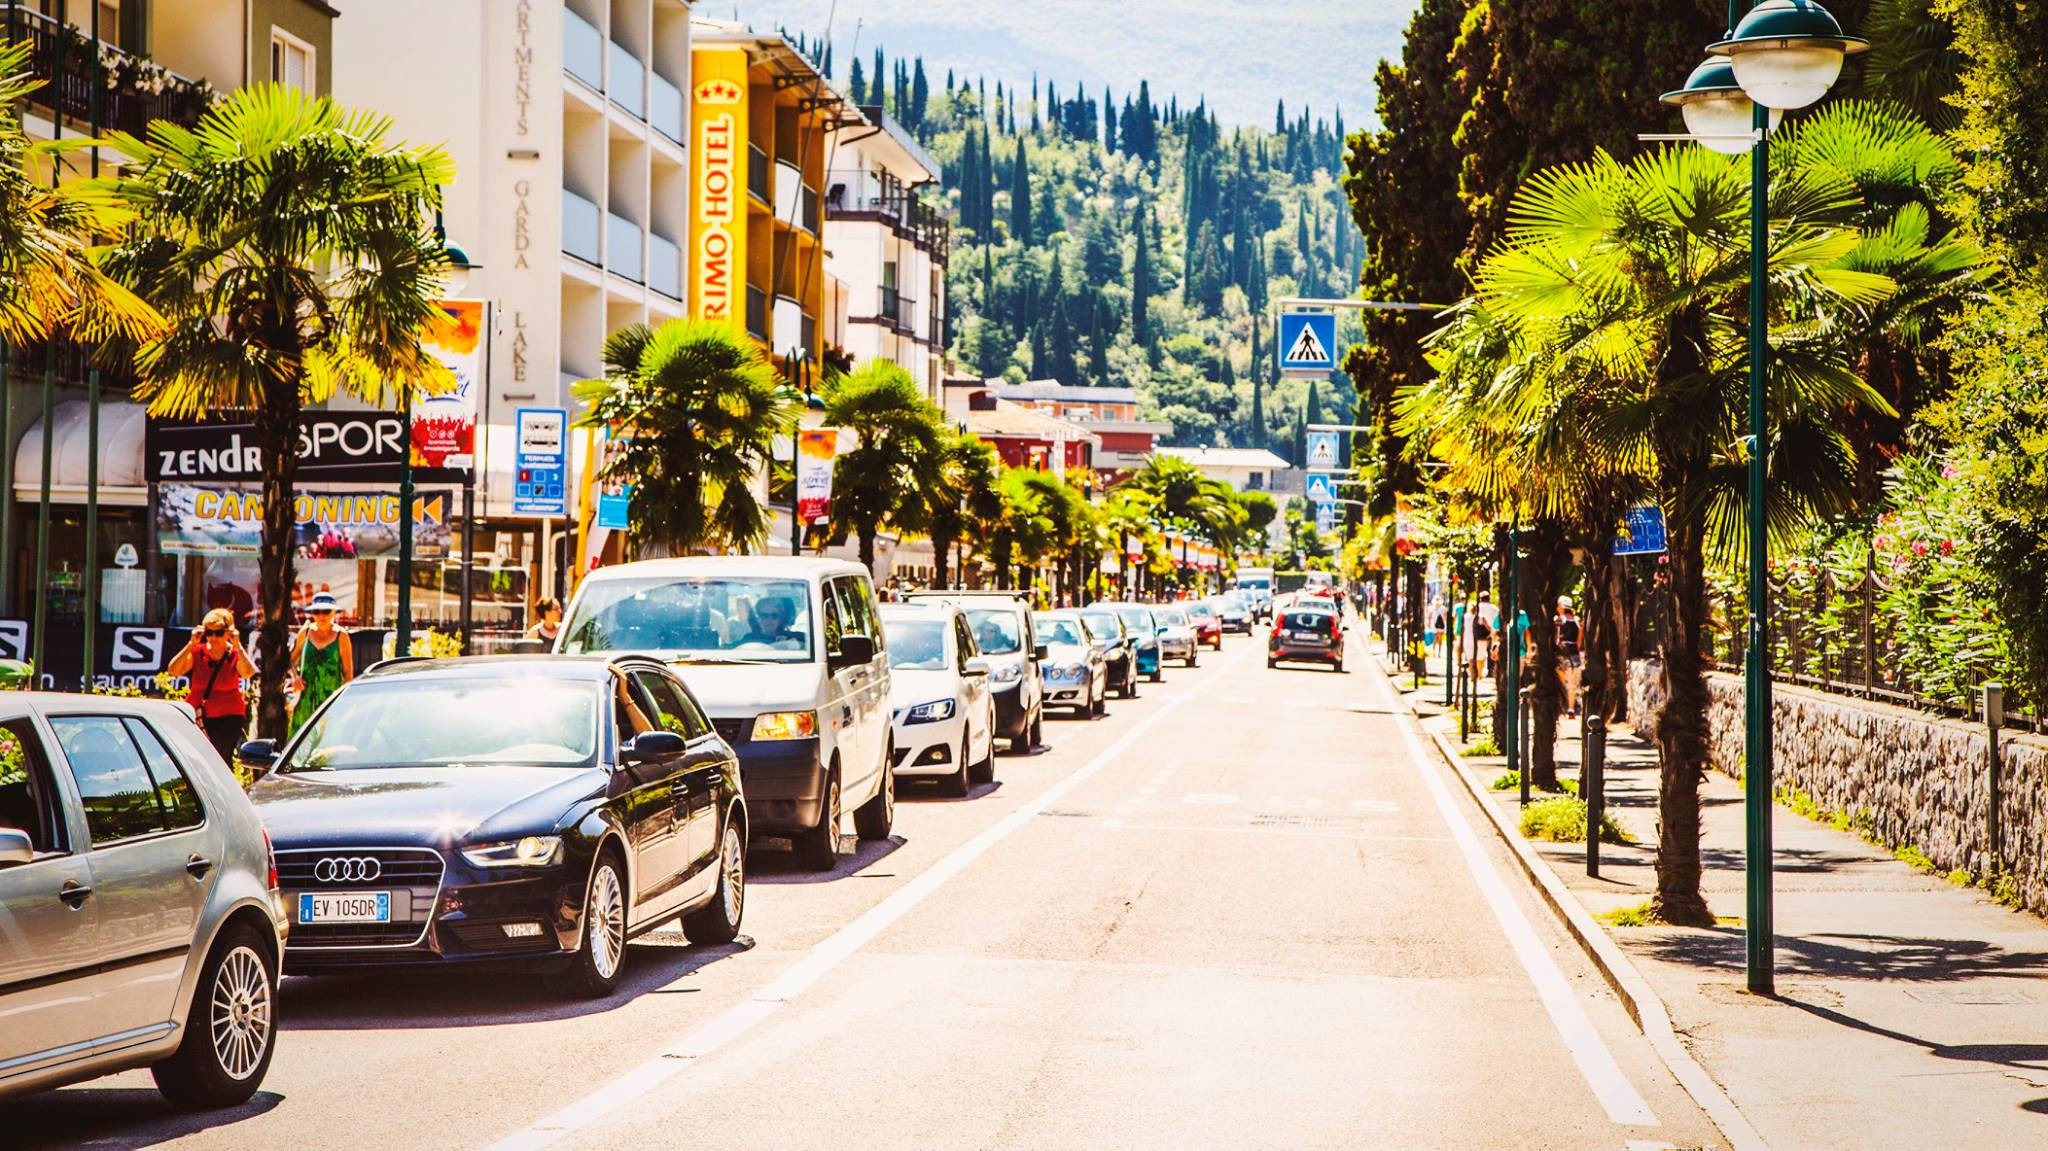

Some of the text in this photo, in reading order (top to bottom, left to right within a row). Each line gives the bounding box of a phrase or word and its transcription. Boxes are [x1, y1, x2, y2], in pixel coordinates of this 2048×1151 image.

[513, 180, 530, 269] GARDA
[704, 118, 729, 321] RIMO HOTEL
[513, 312, 528, 382] LAKE
[159, 433, 263, 476] ZENdR
[294, 419, 403, 459] SPOR
[194, 491, 400, 523] CANONING
[80, 674, 189, 691] salomn
[313, 900, 330, 917] EV
[336, 900, 376, 916] 105DR
